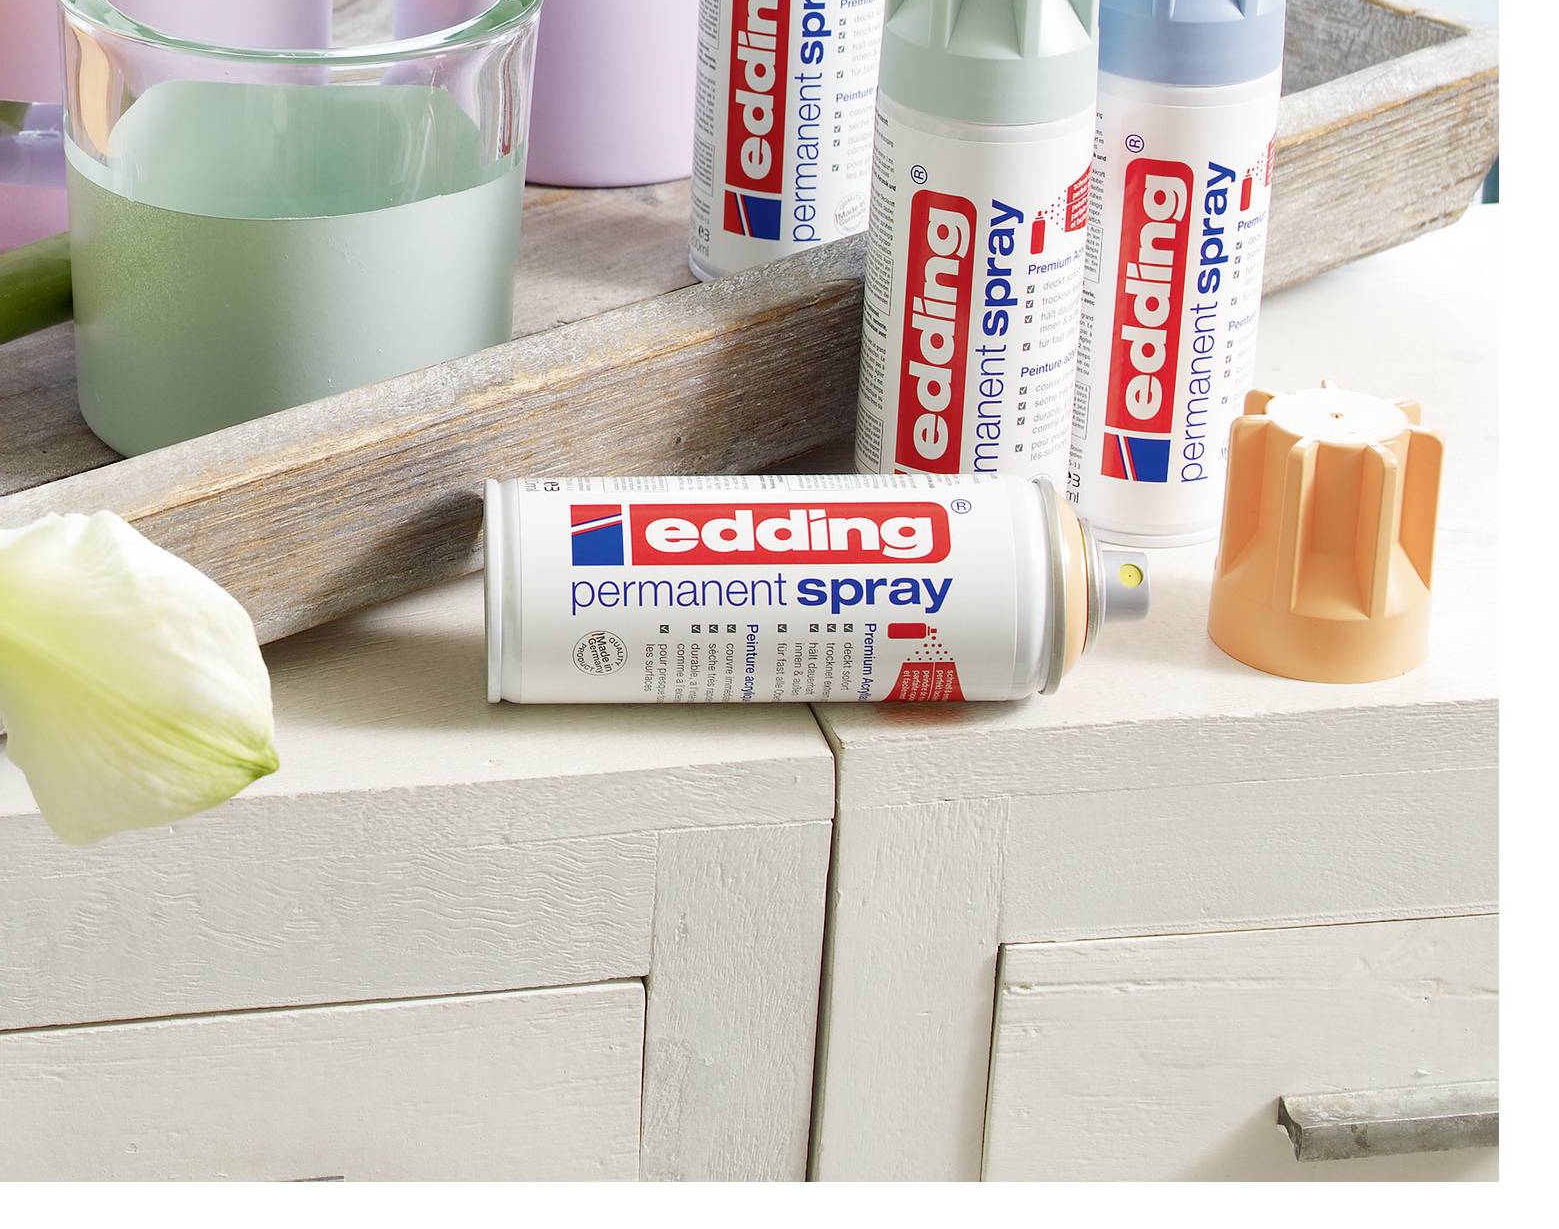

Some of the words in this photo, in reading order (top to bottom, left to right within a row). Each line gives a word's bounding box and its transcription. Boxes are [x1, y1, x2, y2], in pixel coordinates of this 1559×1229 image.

[836, 86, 874, 103] Peinture
[793, 72, 821, 243] permanent
[1197, 162, 1237, 295] spray
[983, 199, 1025, 337] spray
[1027, 255, 1072, 275] Premium
[1121, 175, 1187, 421] edding
[912, 208, 970, 460] edding
[1020, 359, 1062, 378] Peinture
[1181, 302, 1218, 484] permanent
[645, 509, 934, 559] edding
[571, 573, 787, 615] permanent
[796, 576, 953, 616] spray
[576, 643, 595, 672] PRODUCT
[587, 637, 605, 674] Germany
[596, 635, 610, 663] Made
[608, 637, 624, 667] QUALITY
[645, 643, 656, 658] les
[657, 643, 668, 666] pour
[676, 643, 685, 677] comme
[708, 643, 719, 671] sèche
[725, 643, 735, 674] couvre
[745, 624, 759, 674] Peinture
[776, 642, 787, 656] für
[794, 642, 803, 668] innen
[808, 642, 818, 660] hält
[824, 642, 836, 678] trocknet
[843, 642, 853, 668] deckt
[861, 623, 876, 674] Premium
[643, 660, 655, 692] surfaces
[776, 659, 786, 675] fast
[841, 670, 851, 691] sofort
